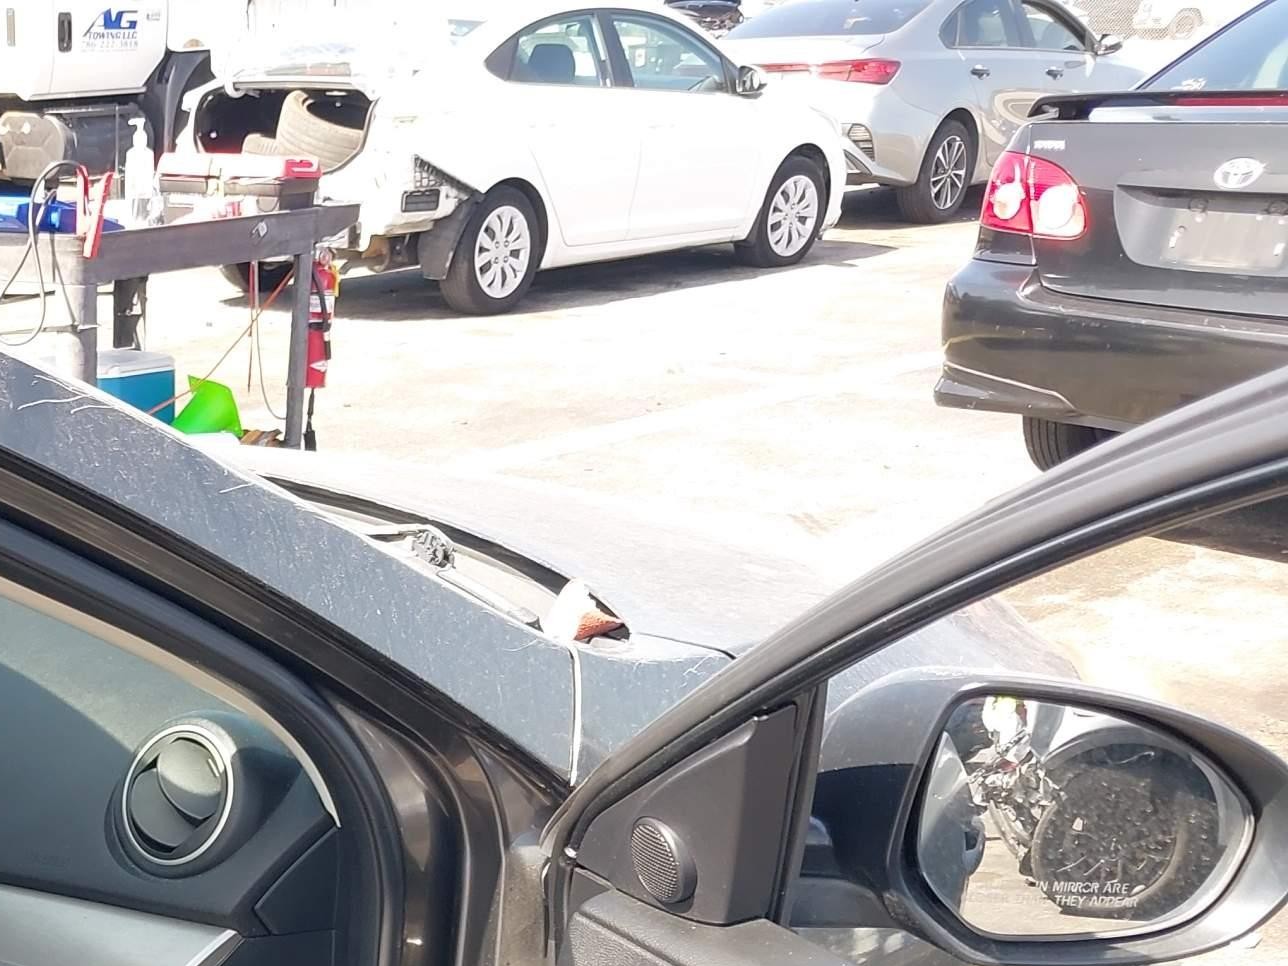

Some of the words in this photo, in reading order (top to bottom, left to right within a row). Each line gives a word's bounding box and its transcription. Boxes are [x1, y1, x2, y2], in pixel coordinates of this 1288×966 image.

[88, 31, 122, 40] TOWING
[123, 31, 138, 40] LLC
[1052, 881, 1100, 894] MIRROR
[1103, 881, 1130, 894] ARE
[1054, 895, 1086, 908] THEY
